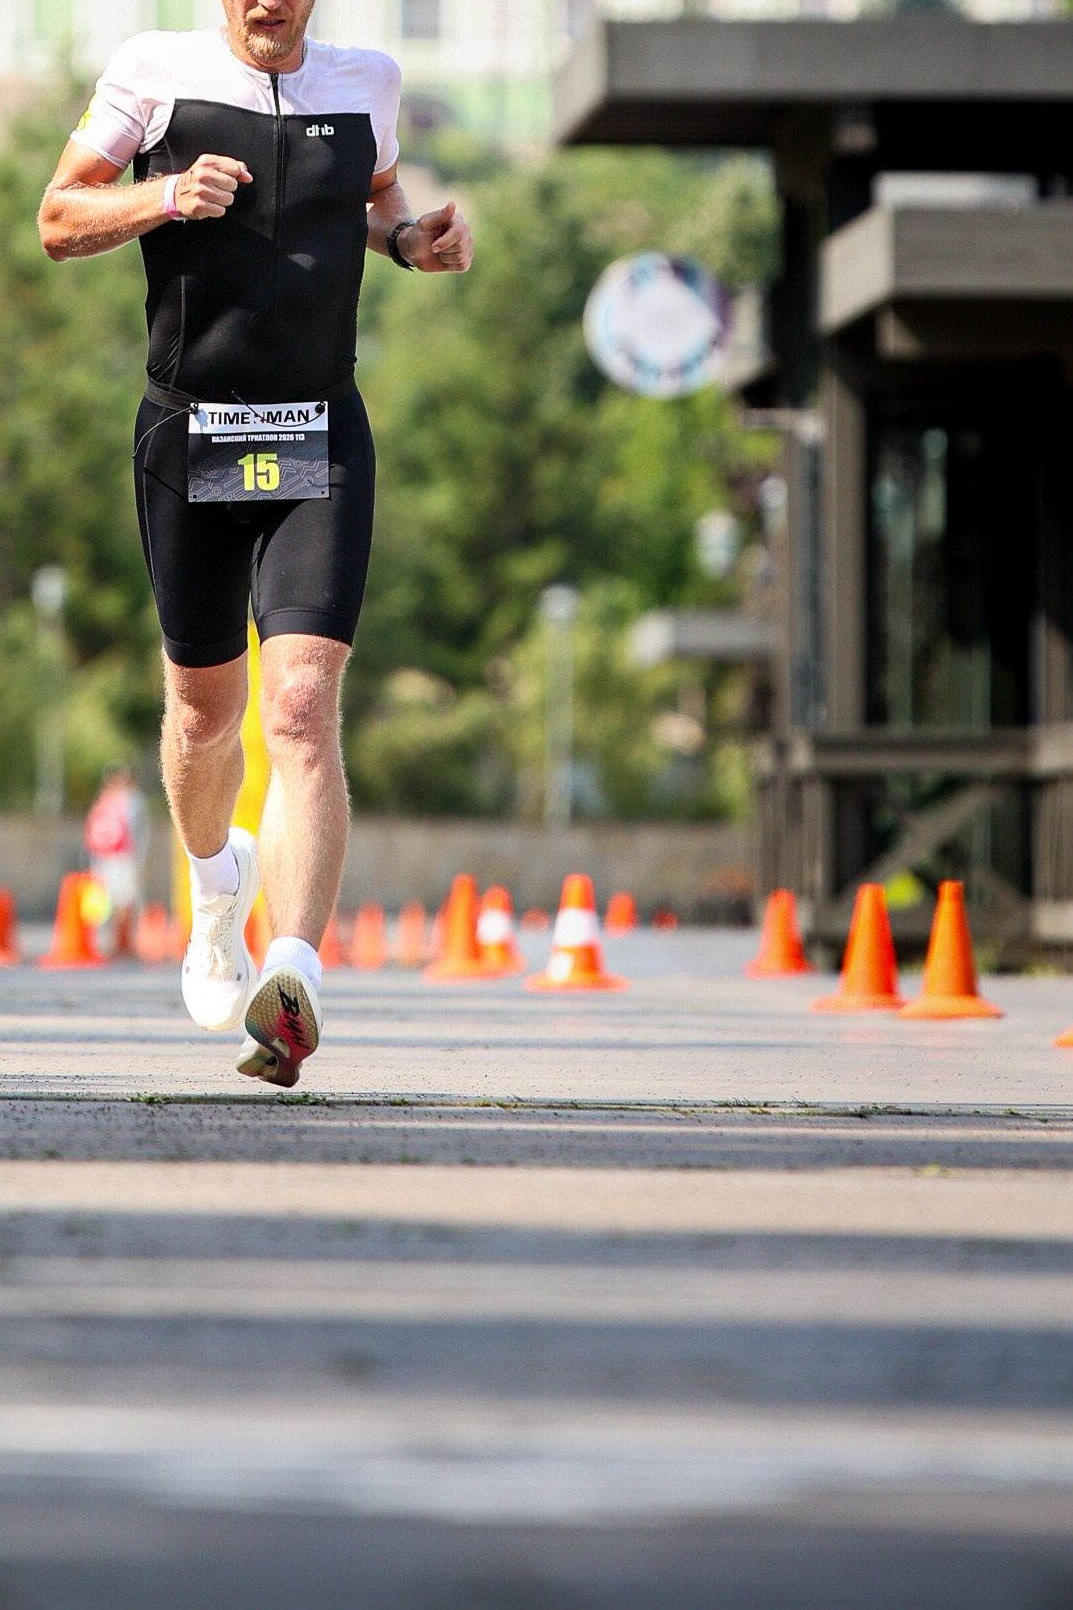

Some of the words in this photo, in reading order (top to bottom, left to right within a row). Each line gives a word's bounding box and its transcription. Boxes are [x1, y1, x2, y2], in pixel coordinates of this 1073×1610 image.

[306, 123, 335, 137] dhb
[247, 433, 278, 442] ТРИАТЛОН
[295, 433, 305, 442] 113
[237, 453, 280, 491] 15
